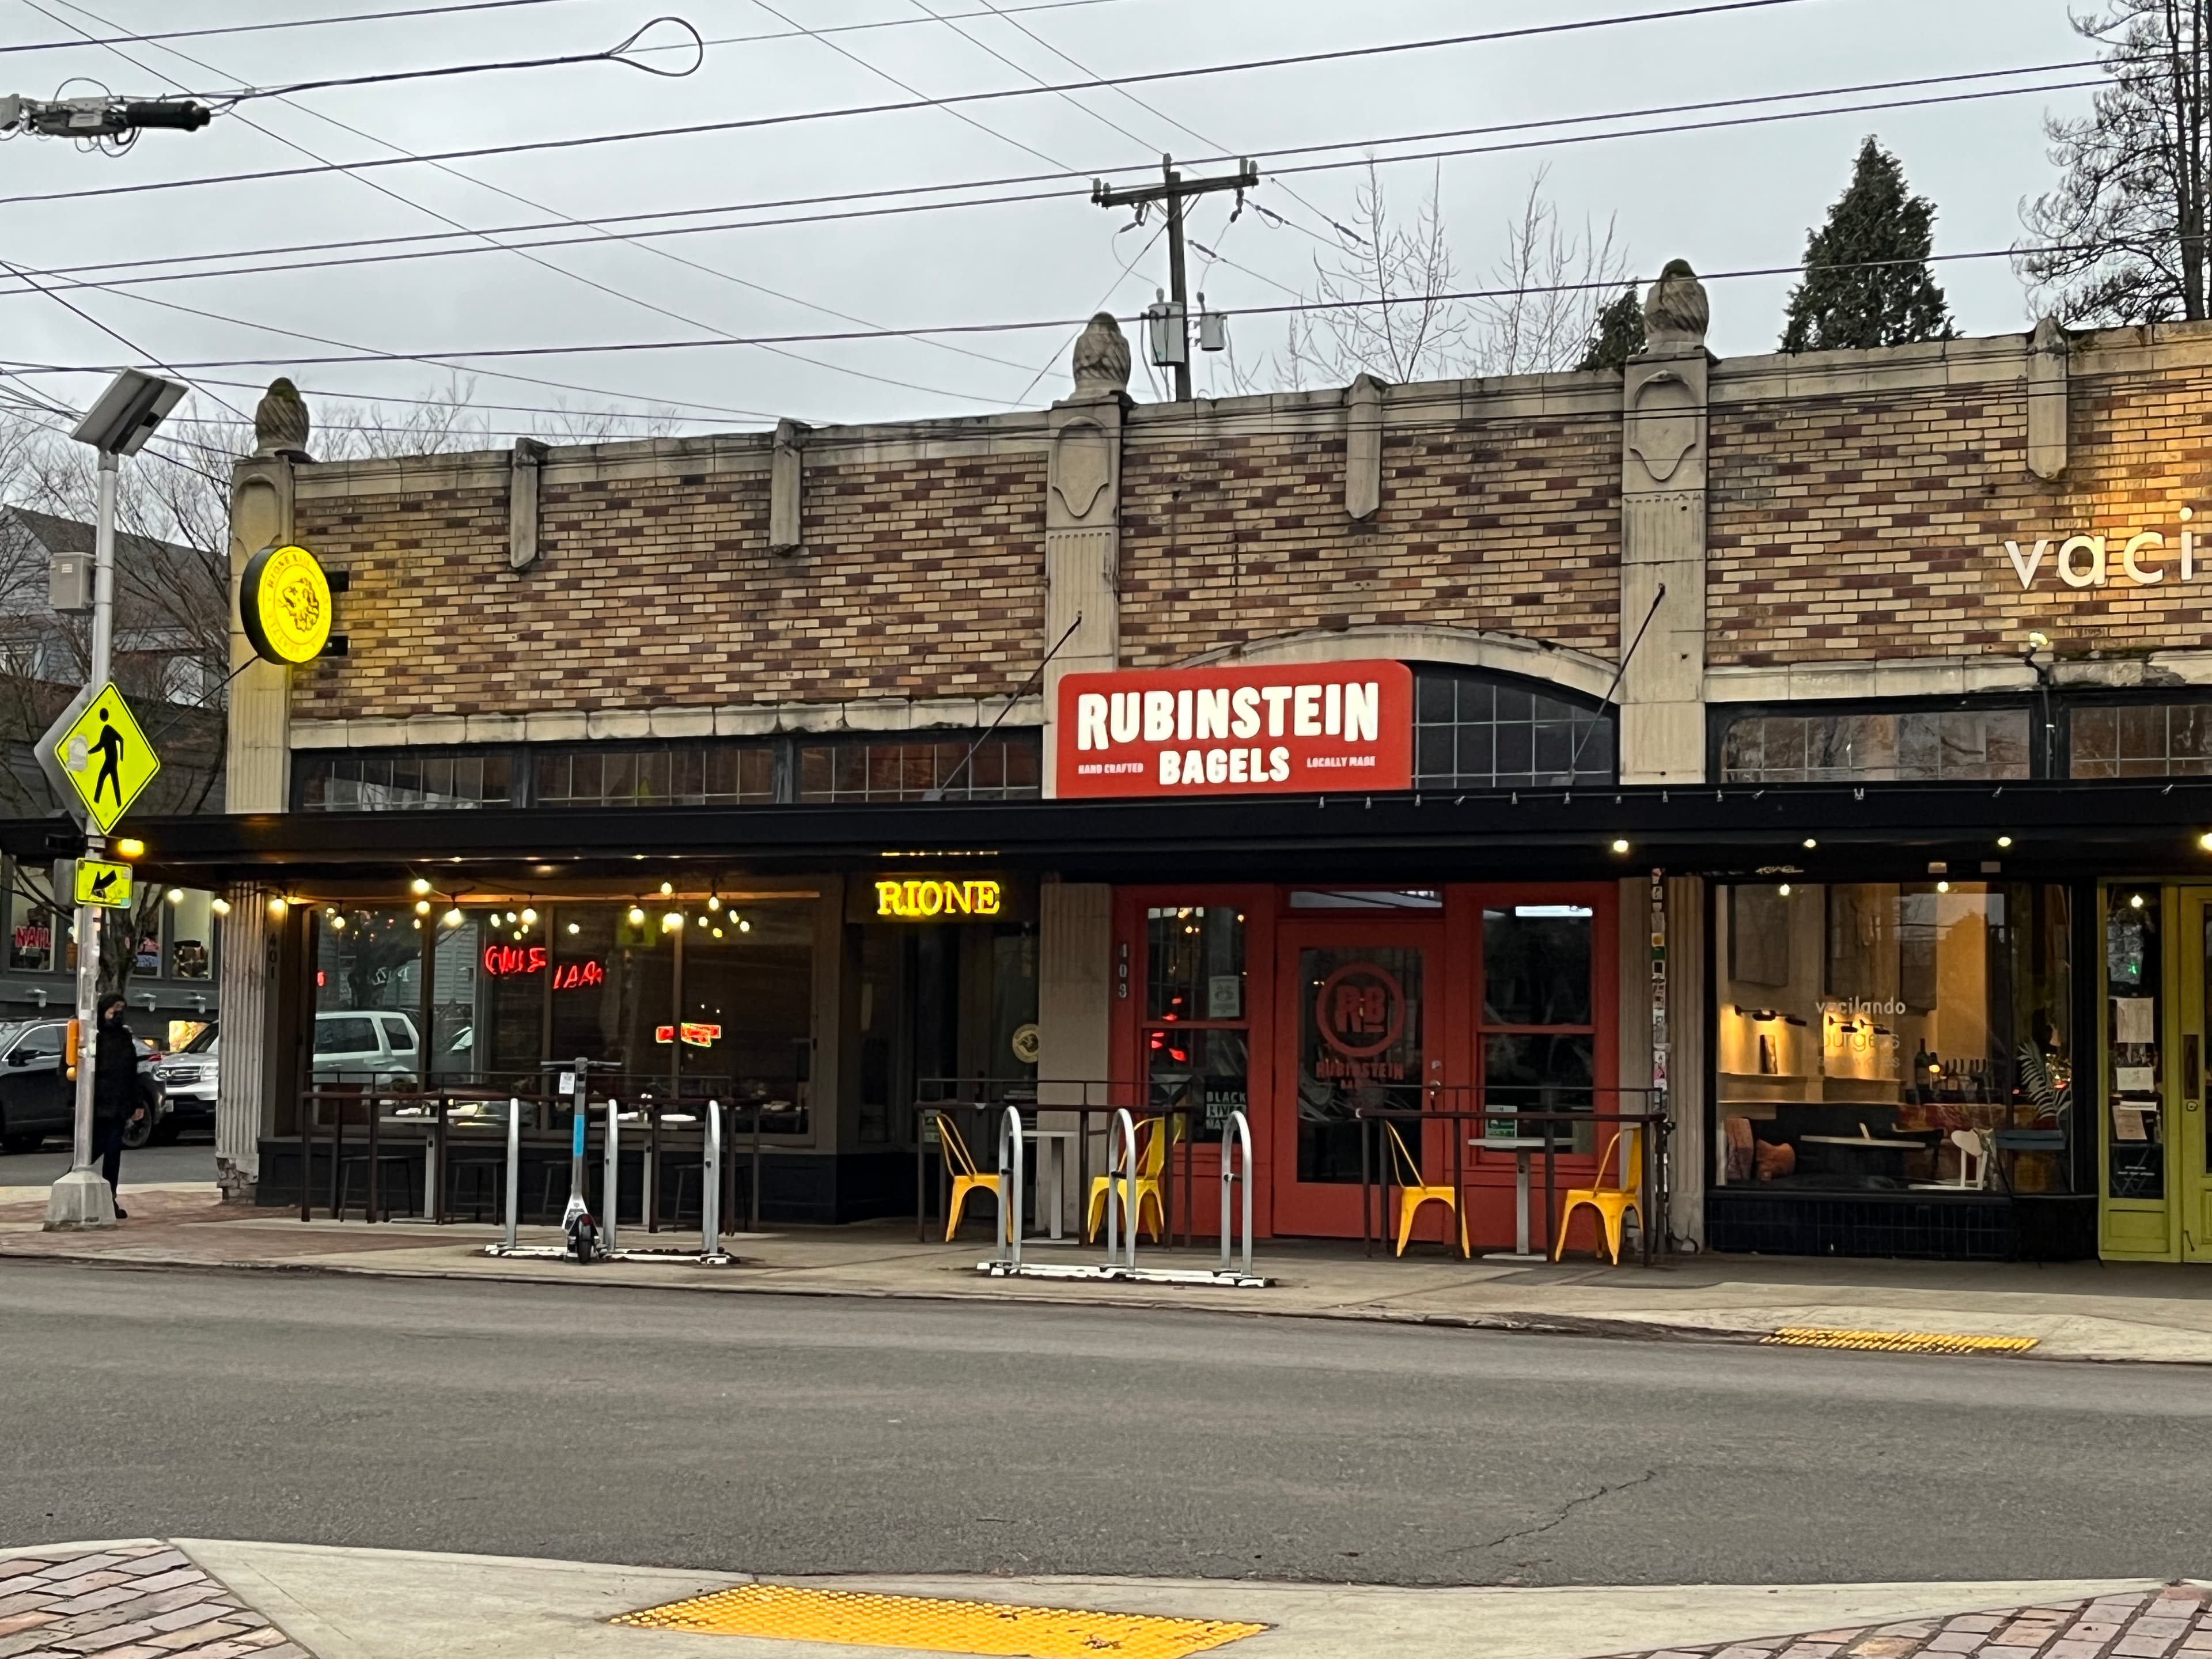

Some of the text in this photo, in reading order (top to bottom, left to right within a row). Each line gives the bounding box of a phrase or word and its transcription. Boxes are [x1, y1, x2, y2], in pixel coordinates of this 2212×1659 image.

[2004, 507, 2193, 590] vaci
[1078, 682, 1378, 751] RUBINSTEIN
[1078, 763, 1143, 774] HAND CRAFTED
[1159, 747, 1290, 785] BAGELS
[1306, 756, 1376, 767] LOCALLY MADE
[875, 881, 1000, 915] RIONE
[1335, 986, 1385, 1033] RB
[1316, 1061, 1404, 1080] RUBINSTEIN
[1207, 1091, 1246, 1103] BLACK
